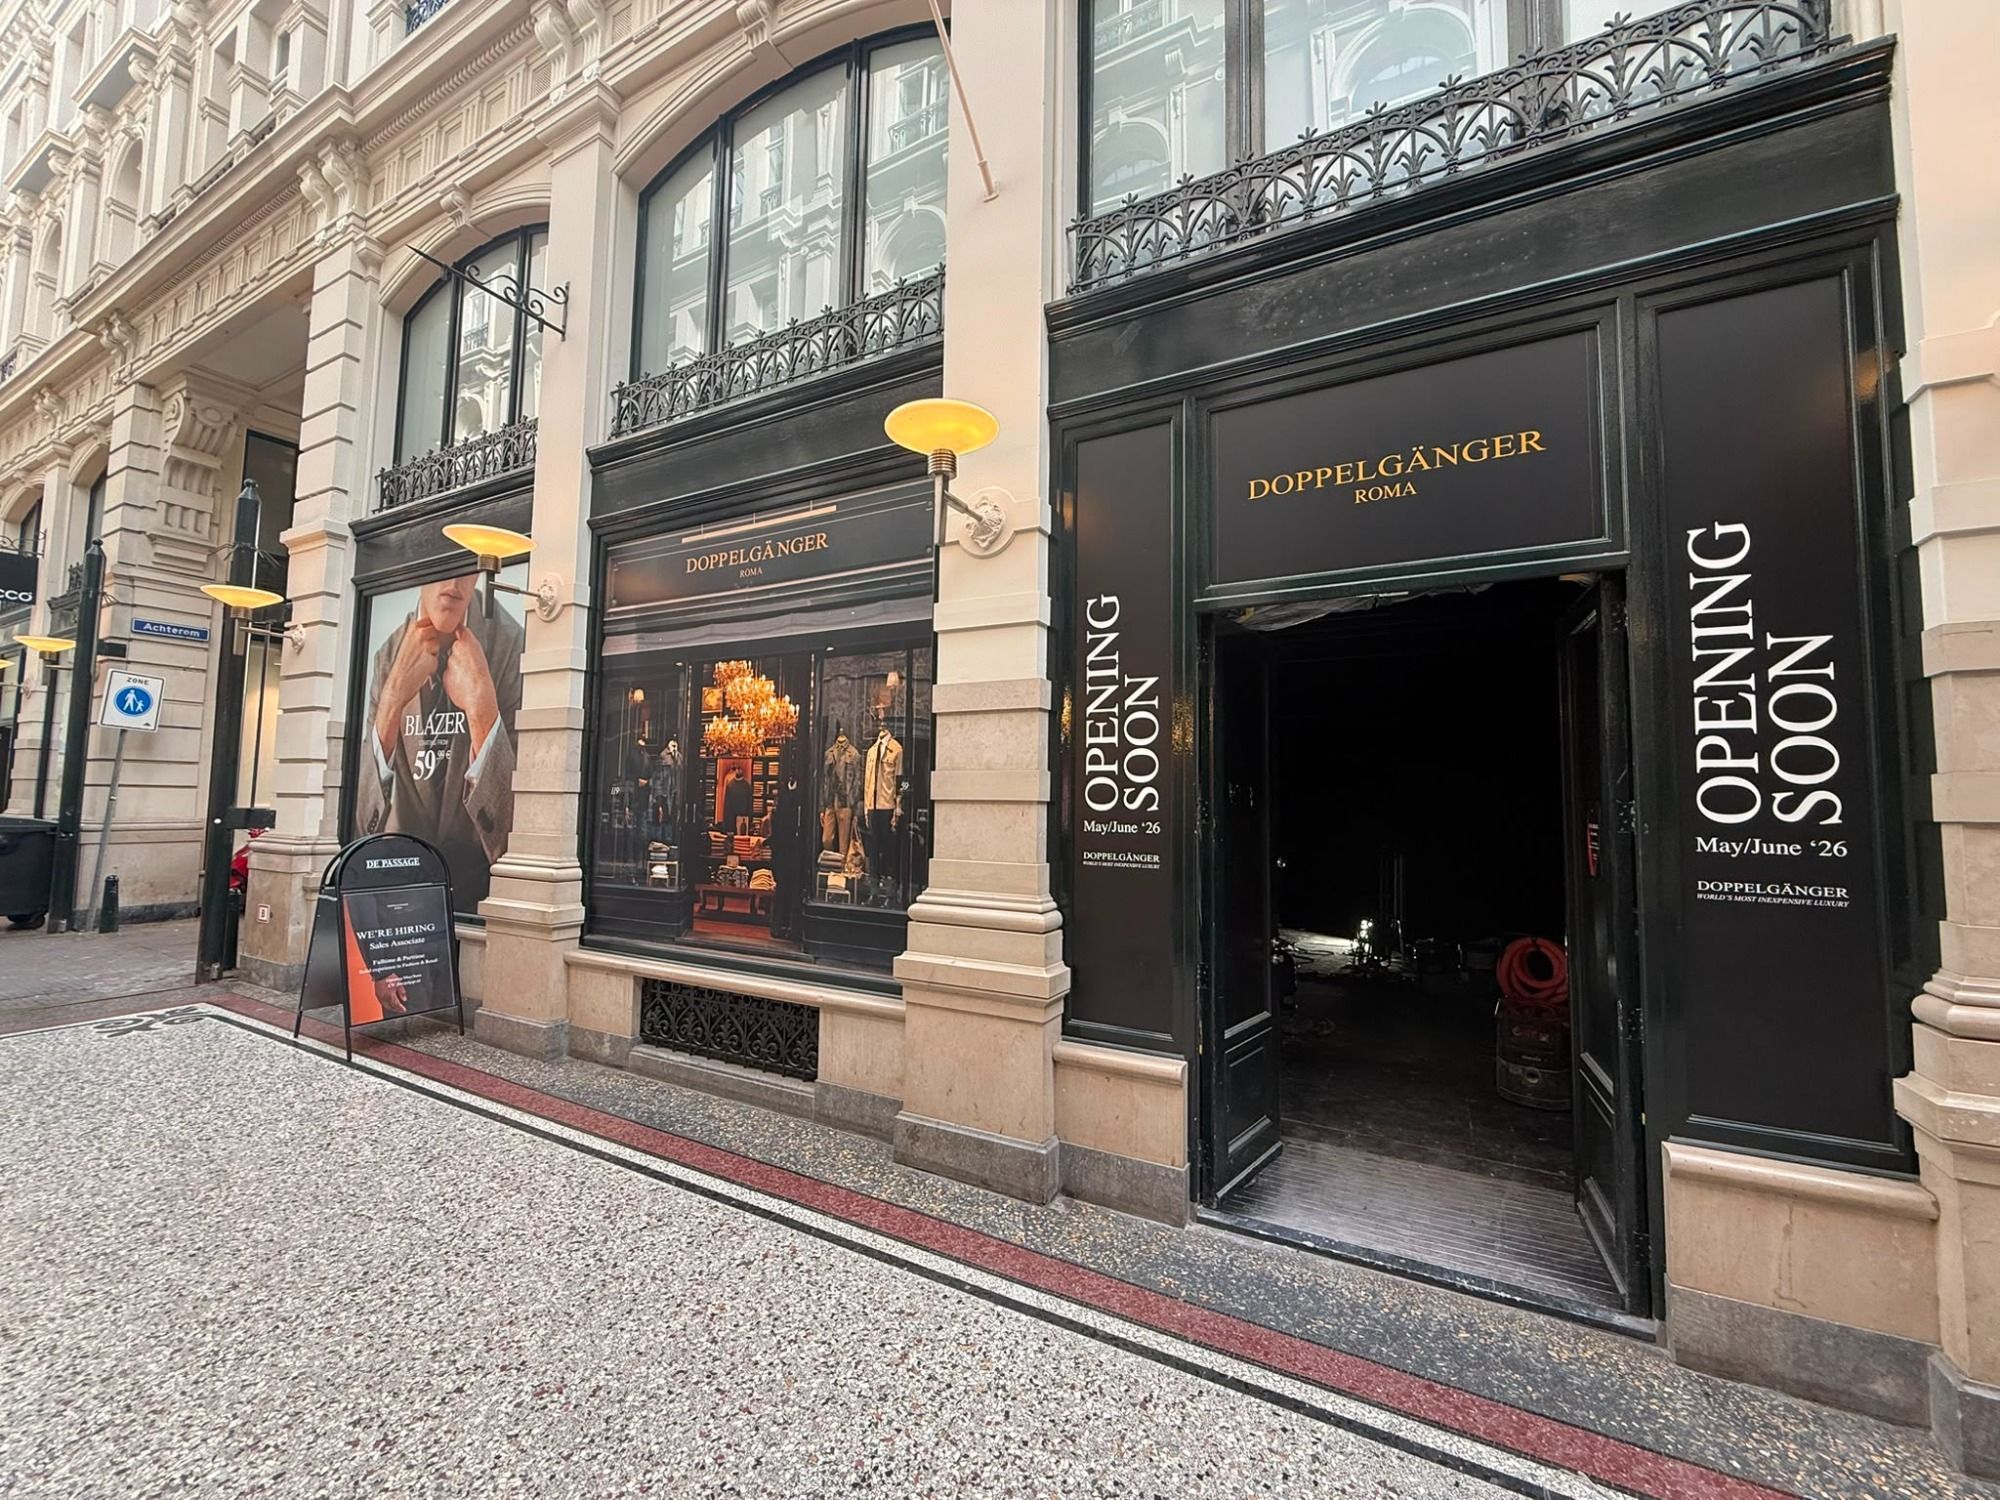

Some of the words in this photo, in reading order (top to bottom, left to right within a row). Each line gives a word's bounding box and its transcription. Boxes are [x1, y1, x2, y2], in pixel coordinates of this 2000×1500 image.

[1248, 429, 1546, 500] DOPPELGÄNGER
[1354, 481, 1417, 504] ROMA
[686, 532, 829, 574] DOPPELGÄNGER
[739, 566, 763, 578] ROMA
[143, 622, 200, 637] Achterom
[127, 677, 150, 685] ZONE
[1687, 521, 1762, 824] OPENING
[1085, 593, 1120, 812] OPENING
[404, 711, 466, 736] BLAZER
[1766, 632, 1843, 825] SOON
[1123, 674, 1160, 812] SOON
[1083, 820, 1138, 835] May/June
[1695, 836, 1802, 857] May/June
[366, 860, 381, 869] DE
[382, 857, 420, 868] PASSAGE
[1083, 851, 1160, 863] DOPPELGÄNGER
[1697, 880, 1849, 898] DOPPELGÄNGER
[1757, 896, 1812, 906] INEXPENSIVE
[1813, 899, 1850, 908] LUXURY
[395, 923, 435, 935] HIRING
[369, 942, 389, 950] Sales
[391, 937, 425, 947] Associate
